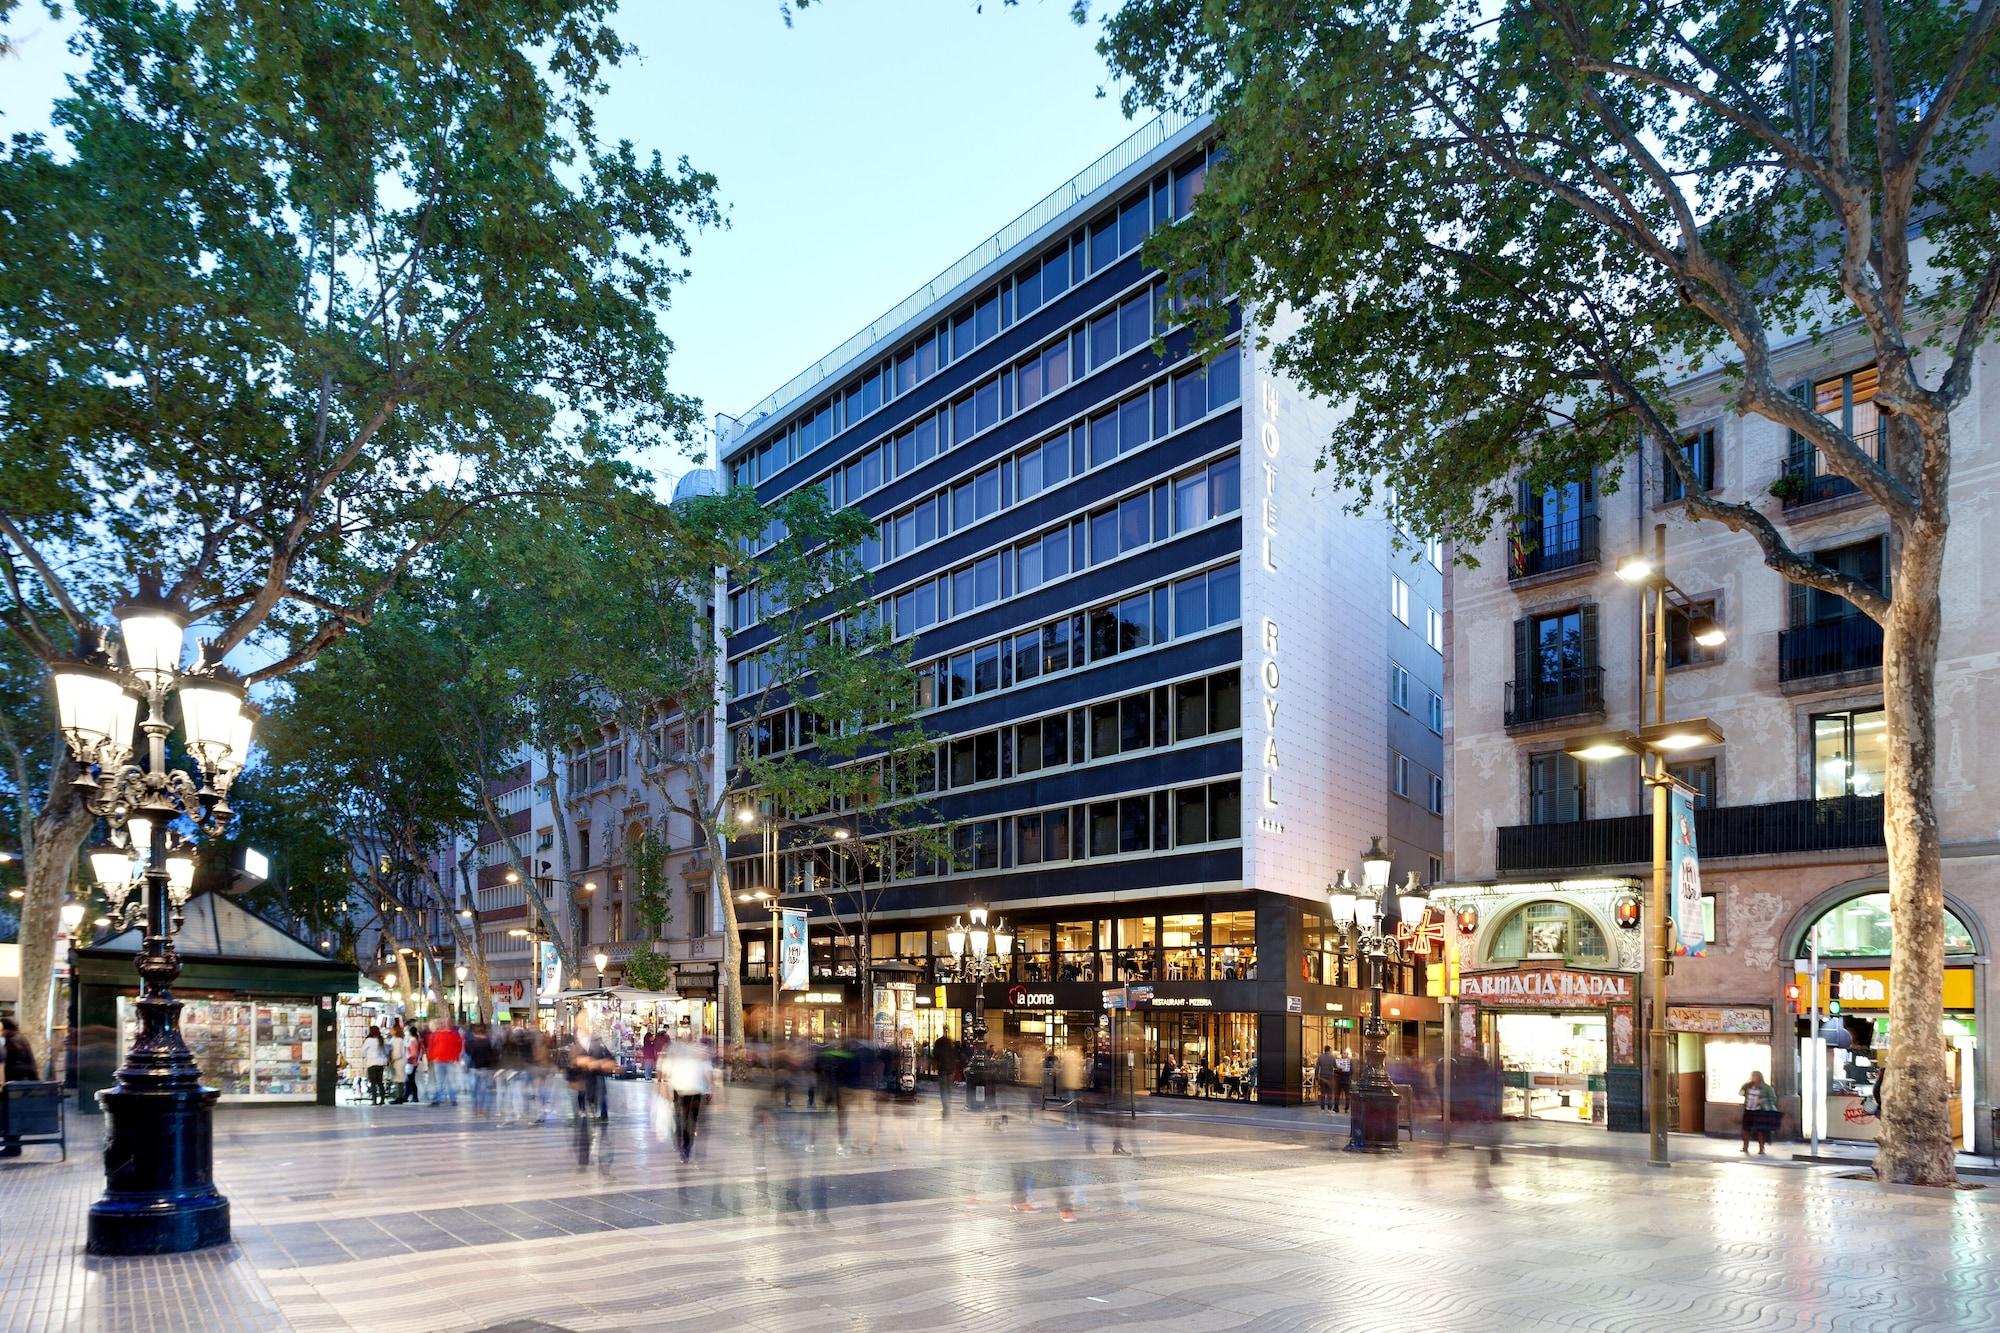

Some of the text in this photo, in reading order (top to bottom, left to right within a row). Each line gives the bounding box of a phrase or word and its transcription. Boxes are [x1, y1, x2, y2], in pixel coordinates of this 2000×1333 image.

[1261, 379, 1280, 807] HOTEL ROYAL
[1560, 974, 1630, 996] NADAL
[1017, 992, 1055, 1007] la poma
[1152, 998, 1213, 1006] RESTAURANT PIZZERIA
